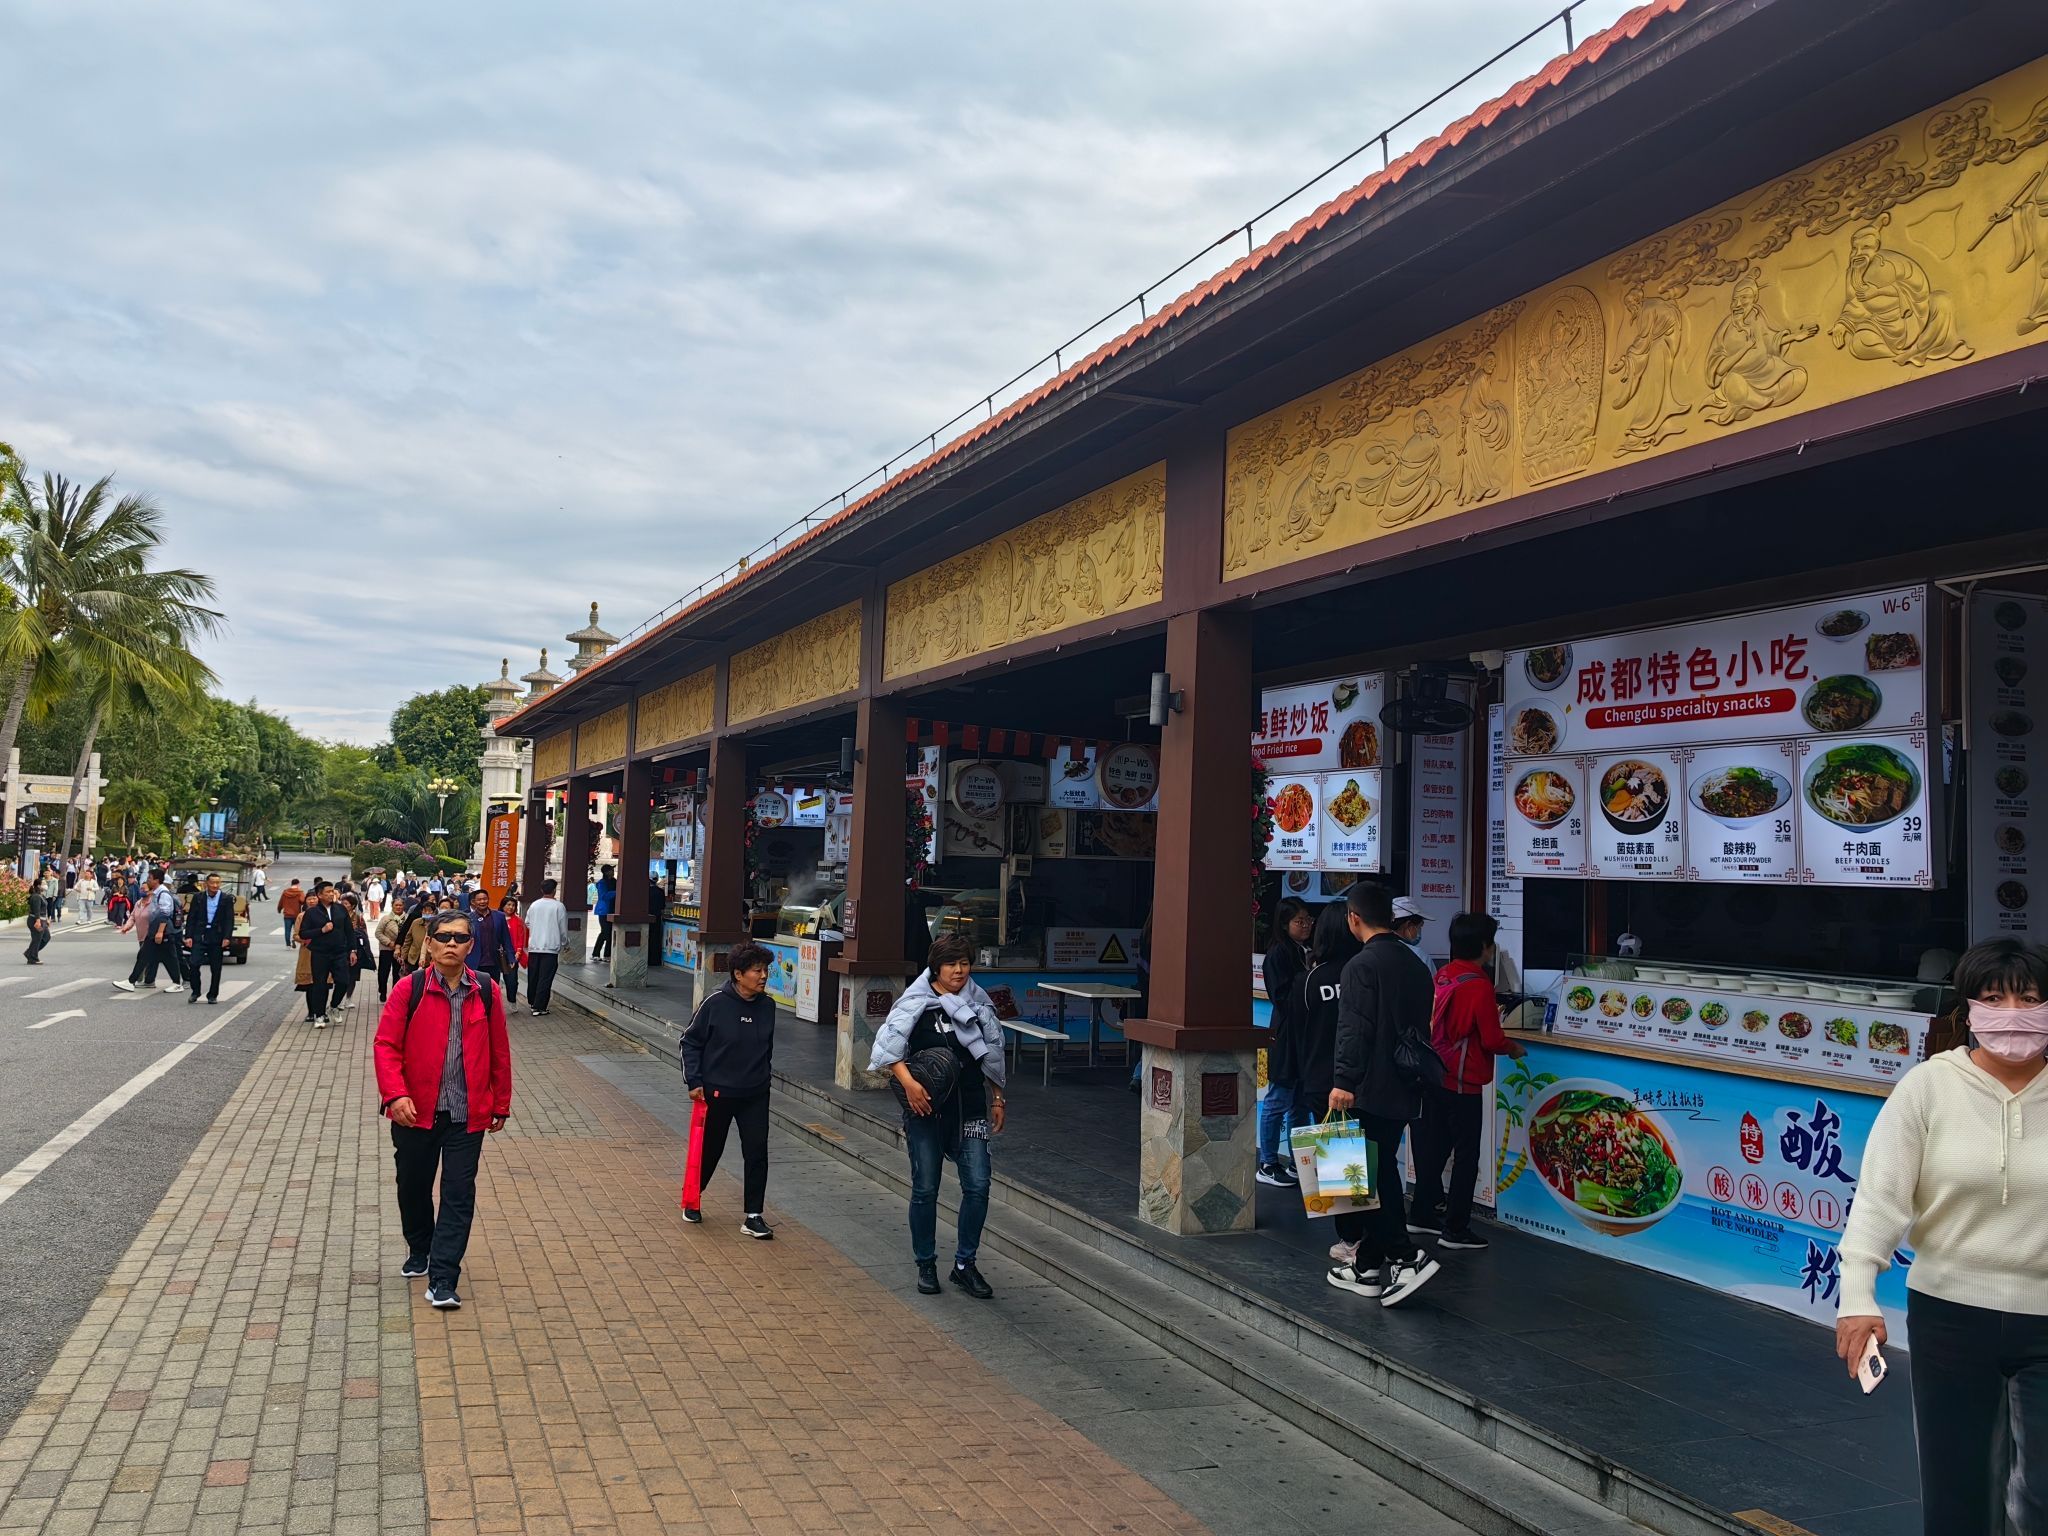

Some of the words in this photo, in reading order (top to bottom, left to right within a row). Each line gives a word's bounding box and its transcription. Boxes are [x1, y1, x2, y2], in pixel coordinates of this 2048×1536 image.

[1883, 597, 1911, 614] W-6
[1576, 634, 1809, 704] 成都特色小吃
[1604, 707, 1656, 726] Chengdu
[1660, 699, 1720, 721] specialty
[1723, 694, 1771, 711] snacks
[1267, 744, 1284, 755] Fried
[1285, 744, 1298, 753] rice
[1367, 825, 1377, 836] 36
[1570, 818, 1581, 829] 36
[1664, 820, 1679, 834] 38
[1775, 819, 1791, 833] 36
[1902, 816, 1922, 832] 39
[1532, 837, 1559, 849] 担担面
[1902, 832, 1922, 842] 元/碗
[497, 820, 510, 887] 食品安全示范街
[1616, 842, 1655, 855] 菌菇素面
[1723, 841, 1757, 856] 酸辣粉
[1843, 841, 1882, 857] 牛肉面
[1835, 857, 1853, 865] BEEF
[1855, 857, 1890, 865] NOODLES
[1632, 1088, 1704, 1108] 美味无法抵挡
[1741, 1123, 1761, 1164] 特色
[1711, 1206, 1732, 1218] HOT
[1734, 1211, 1755, 1223] AND
[1757, 1217, 1785, 1233] SOUR
[1711, 1217, 1733, 1230] RICE
[1734, 1221, 1779, 1242] NOODLES
